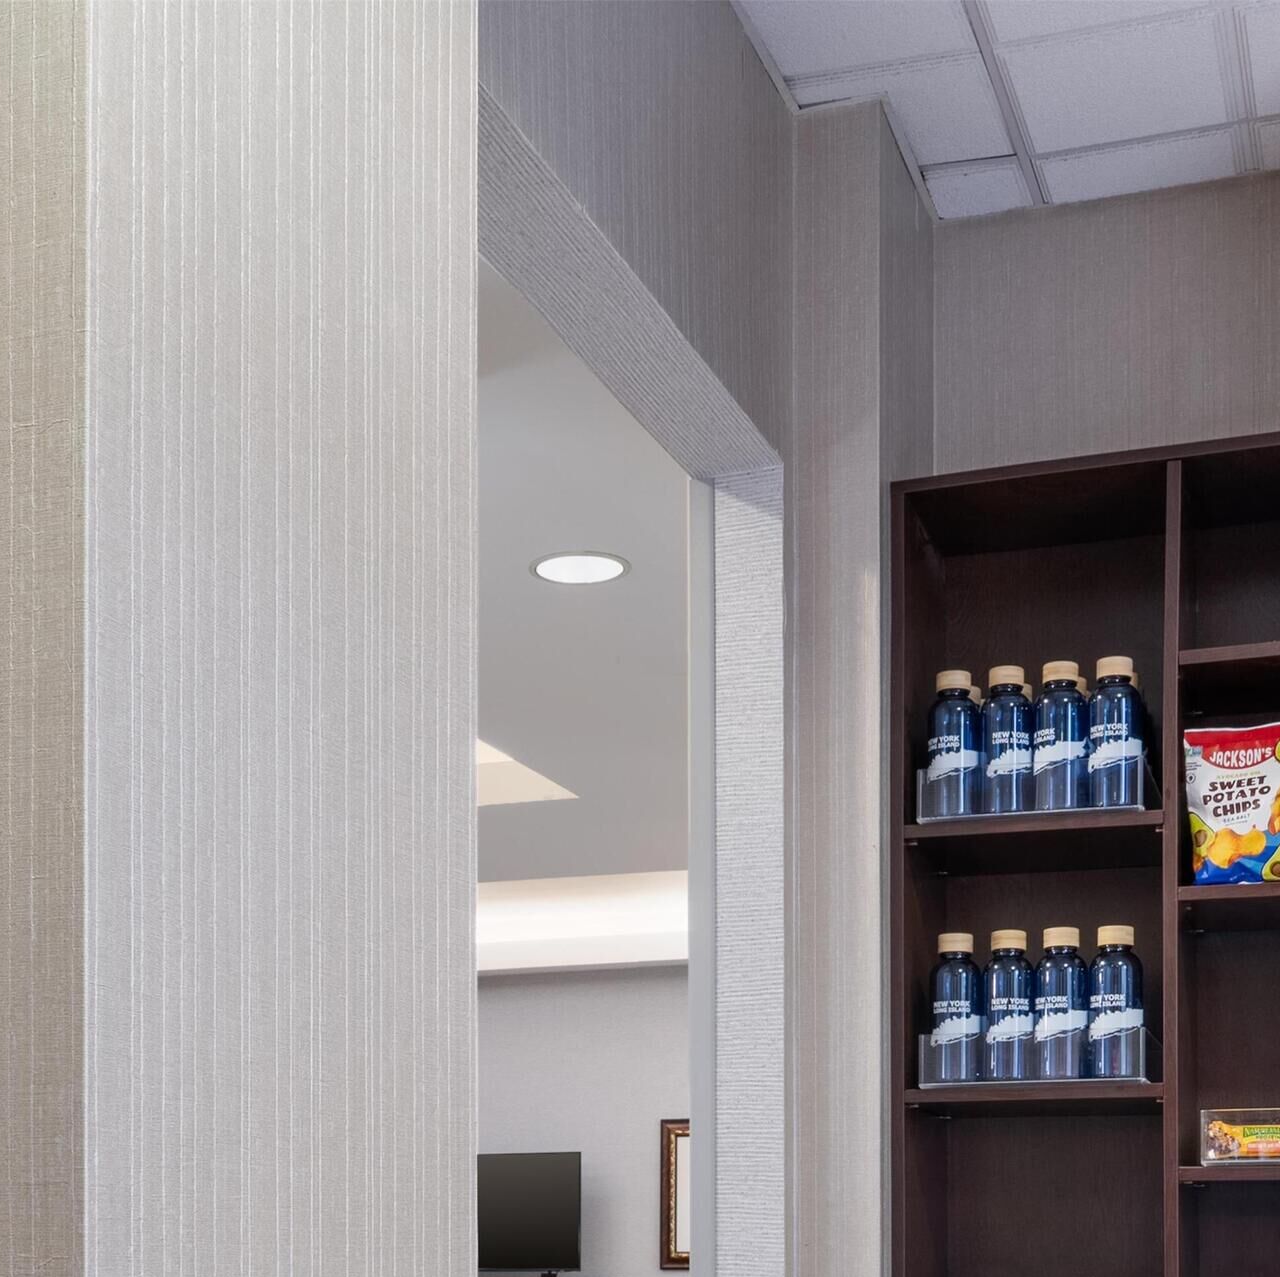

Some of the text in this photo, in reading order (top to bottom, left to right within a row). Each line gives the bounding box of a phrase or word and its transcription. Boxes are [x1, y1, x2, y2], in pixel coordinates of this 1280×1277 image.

[1209, 746, 1272, 768] JACKSON'S
[1208, 776, 1268, 791] SWEET
[1203, 786, 1271, 805] POTATO
[1213, 799, 1261, 817] CHIPS
[1048, 995, 1068, 1003] YORK
[1105, 993, 1126, 1001] YORK
